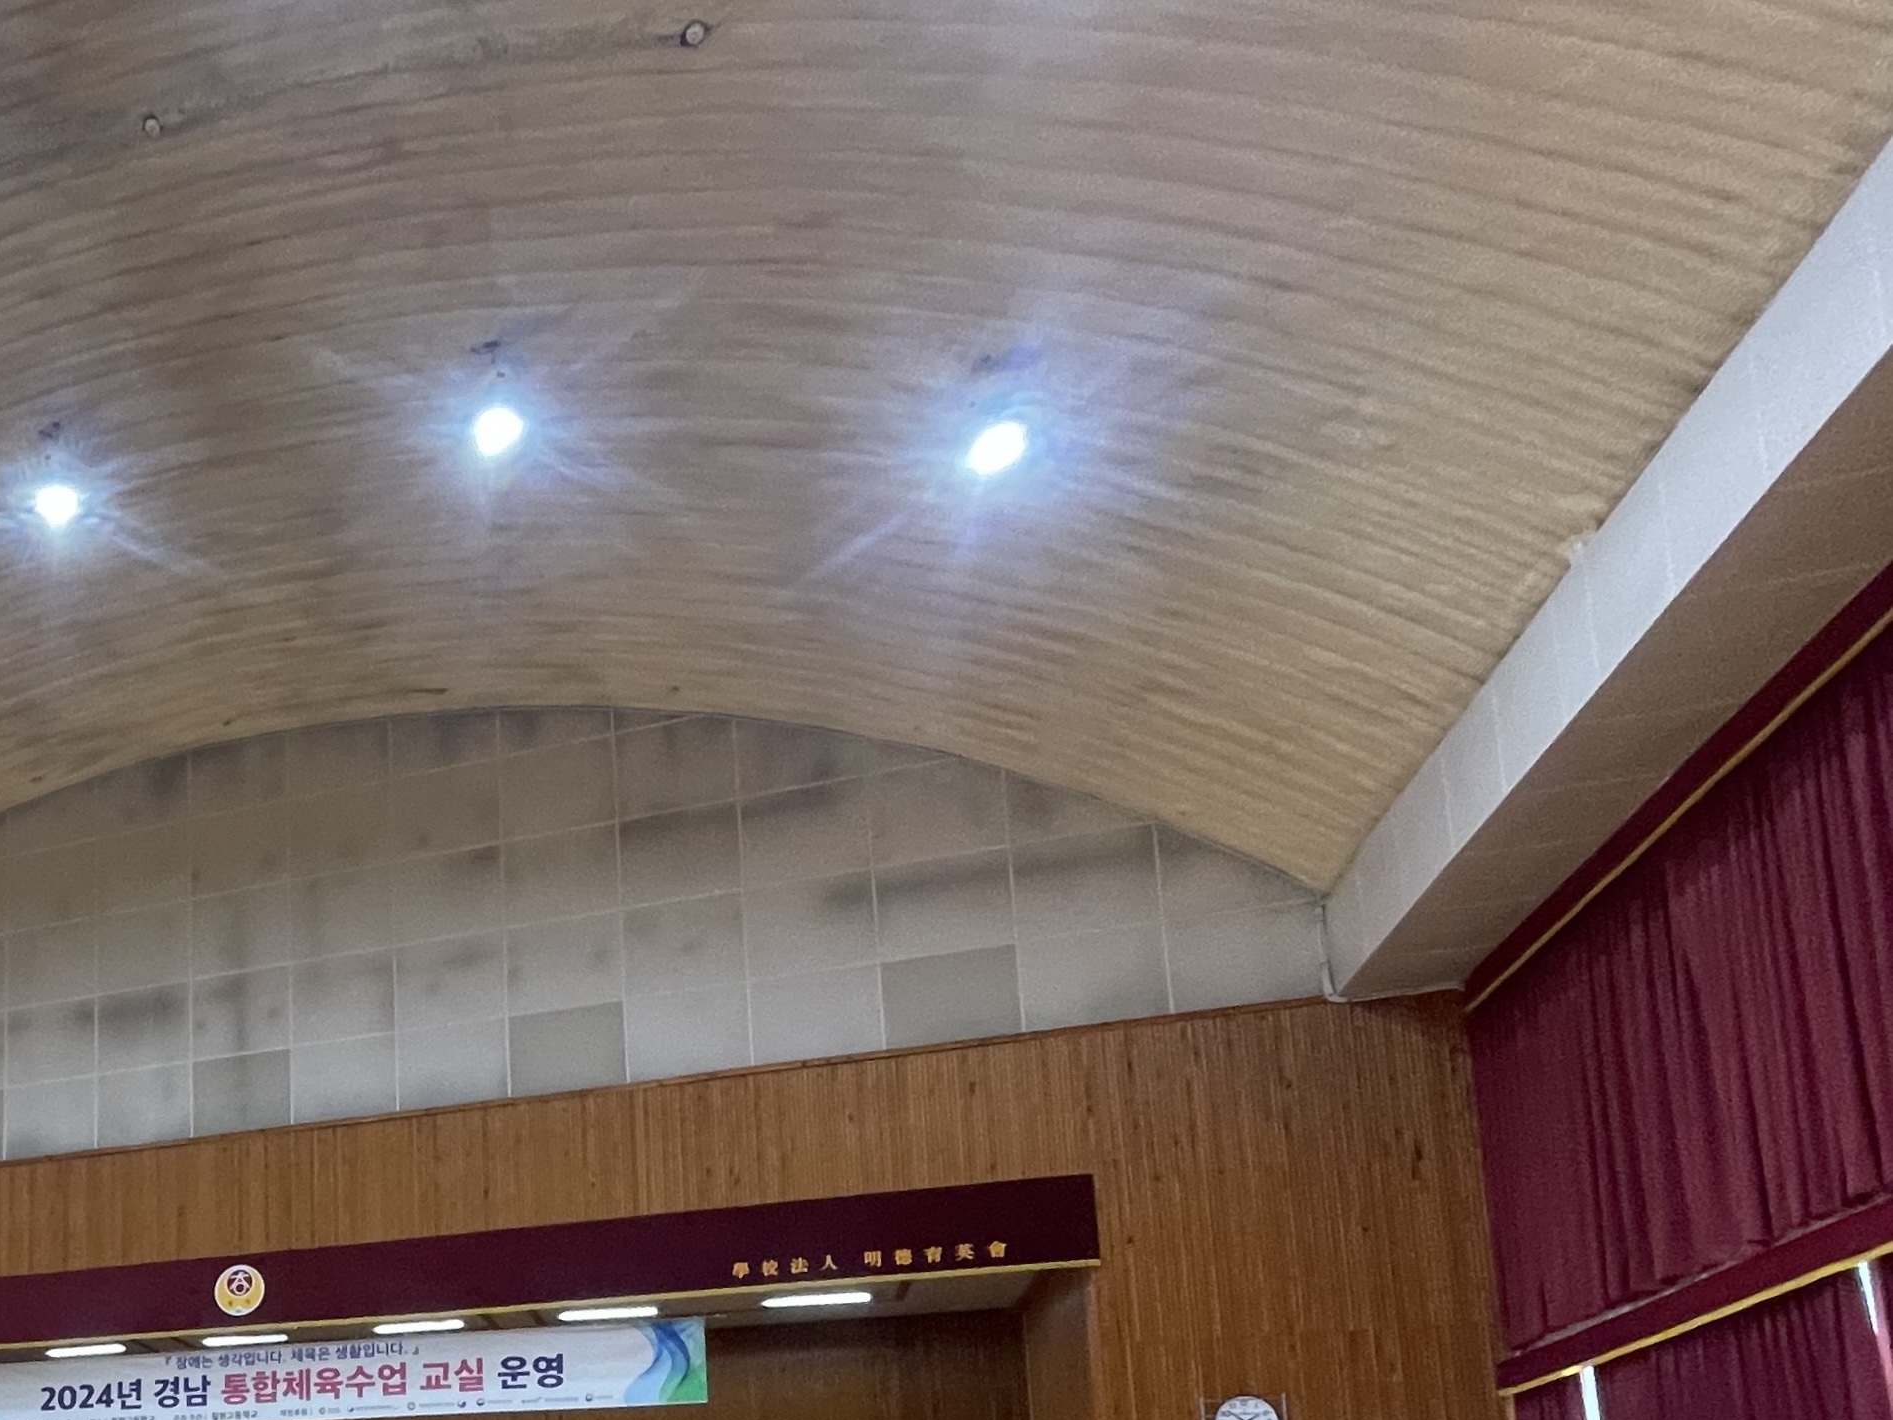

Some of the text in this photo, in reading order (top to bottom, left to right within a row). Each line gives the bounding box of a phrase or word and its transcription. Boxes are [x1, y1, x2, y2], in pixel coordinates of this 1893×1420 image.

[40, 1352, 566, 1411] 2024년 경남 통합체육수업 교실 운영
